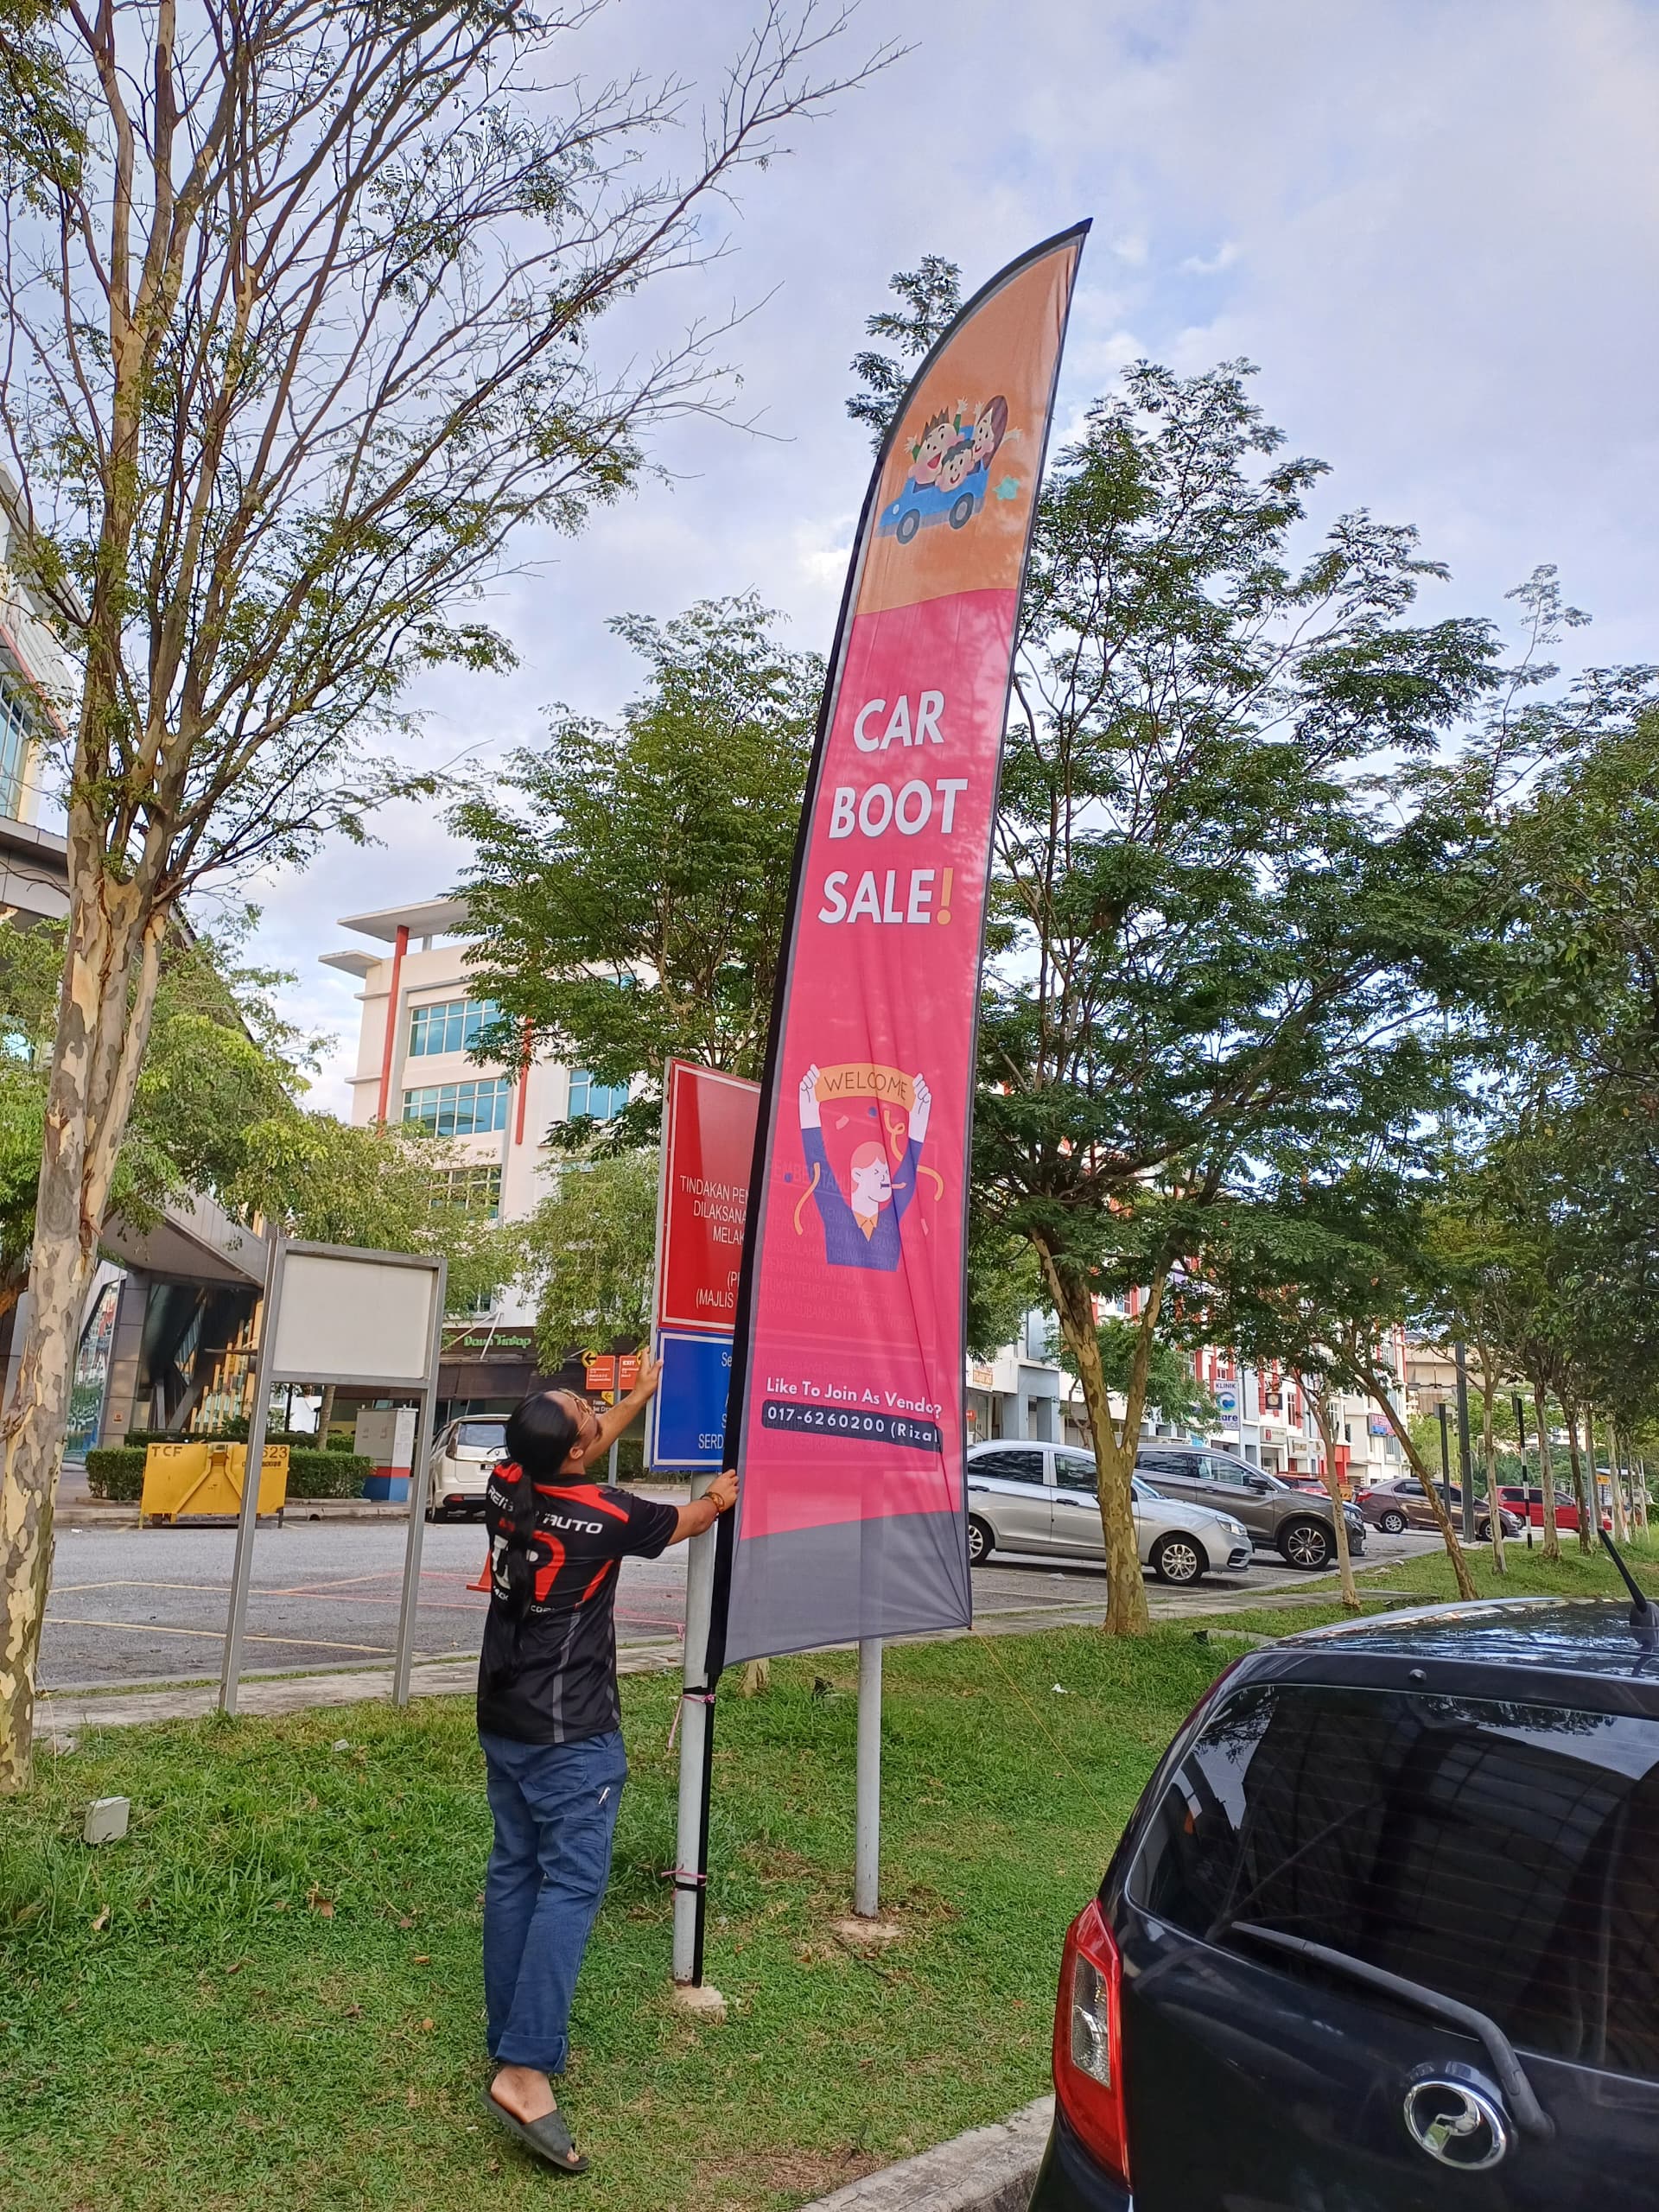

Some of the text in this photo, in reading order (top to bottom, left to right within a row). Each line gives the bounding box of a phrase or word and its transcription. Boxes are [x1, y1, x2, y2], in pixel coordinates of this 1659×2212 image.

[853, 690, 944, 753] CAR
[829, 779, 969, 838] BOOT
[817, 867, 955, 925] SALE!
[823, 1071, 907, 1101] WELCOME
[680, 1175, 729, 1202] TINDAKAN
[693, 1200, 747, 1225] DILAKSANA
[696, 1287, 734, 1308] (MAJLIS
[766, 1376, 798, 1395] Like
[802, 1380, 821, 1397] To
[824, 1383, 857, 1402] Join
[861, 1388, 880, 1405] As
[767, 1406, 885, 1433] 017-6260200
[698, 1433, 724, 1449] SERD
